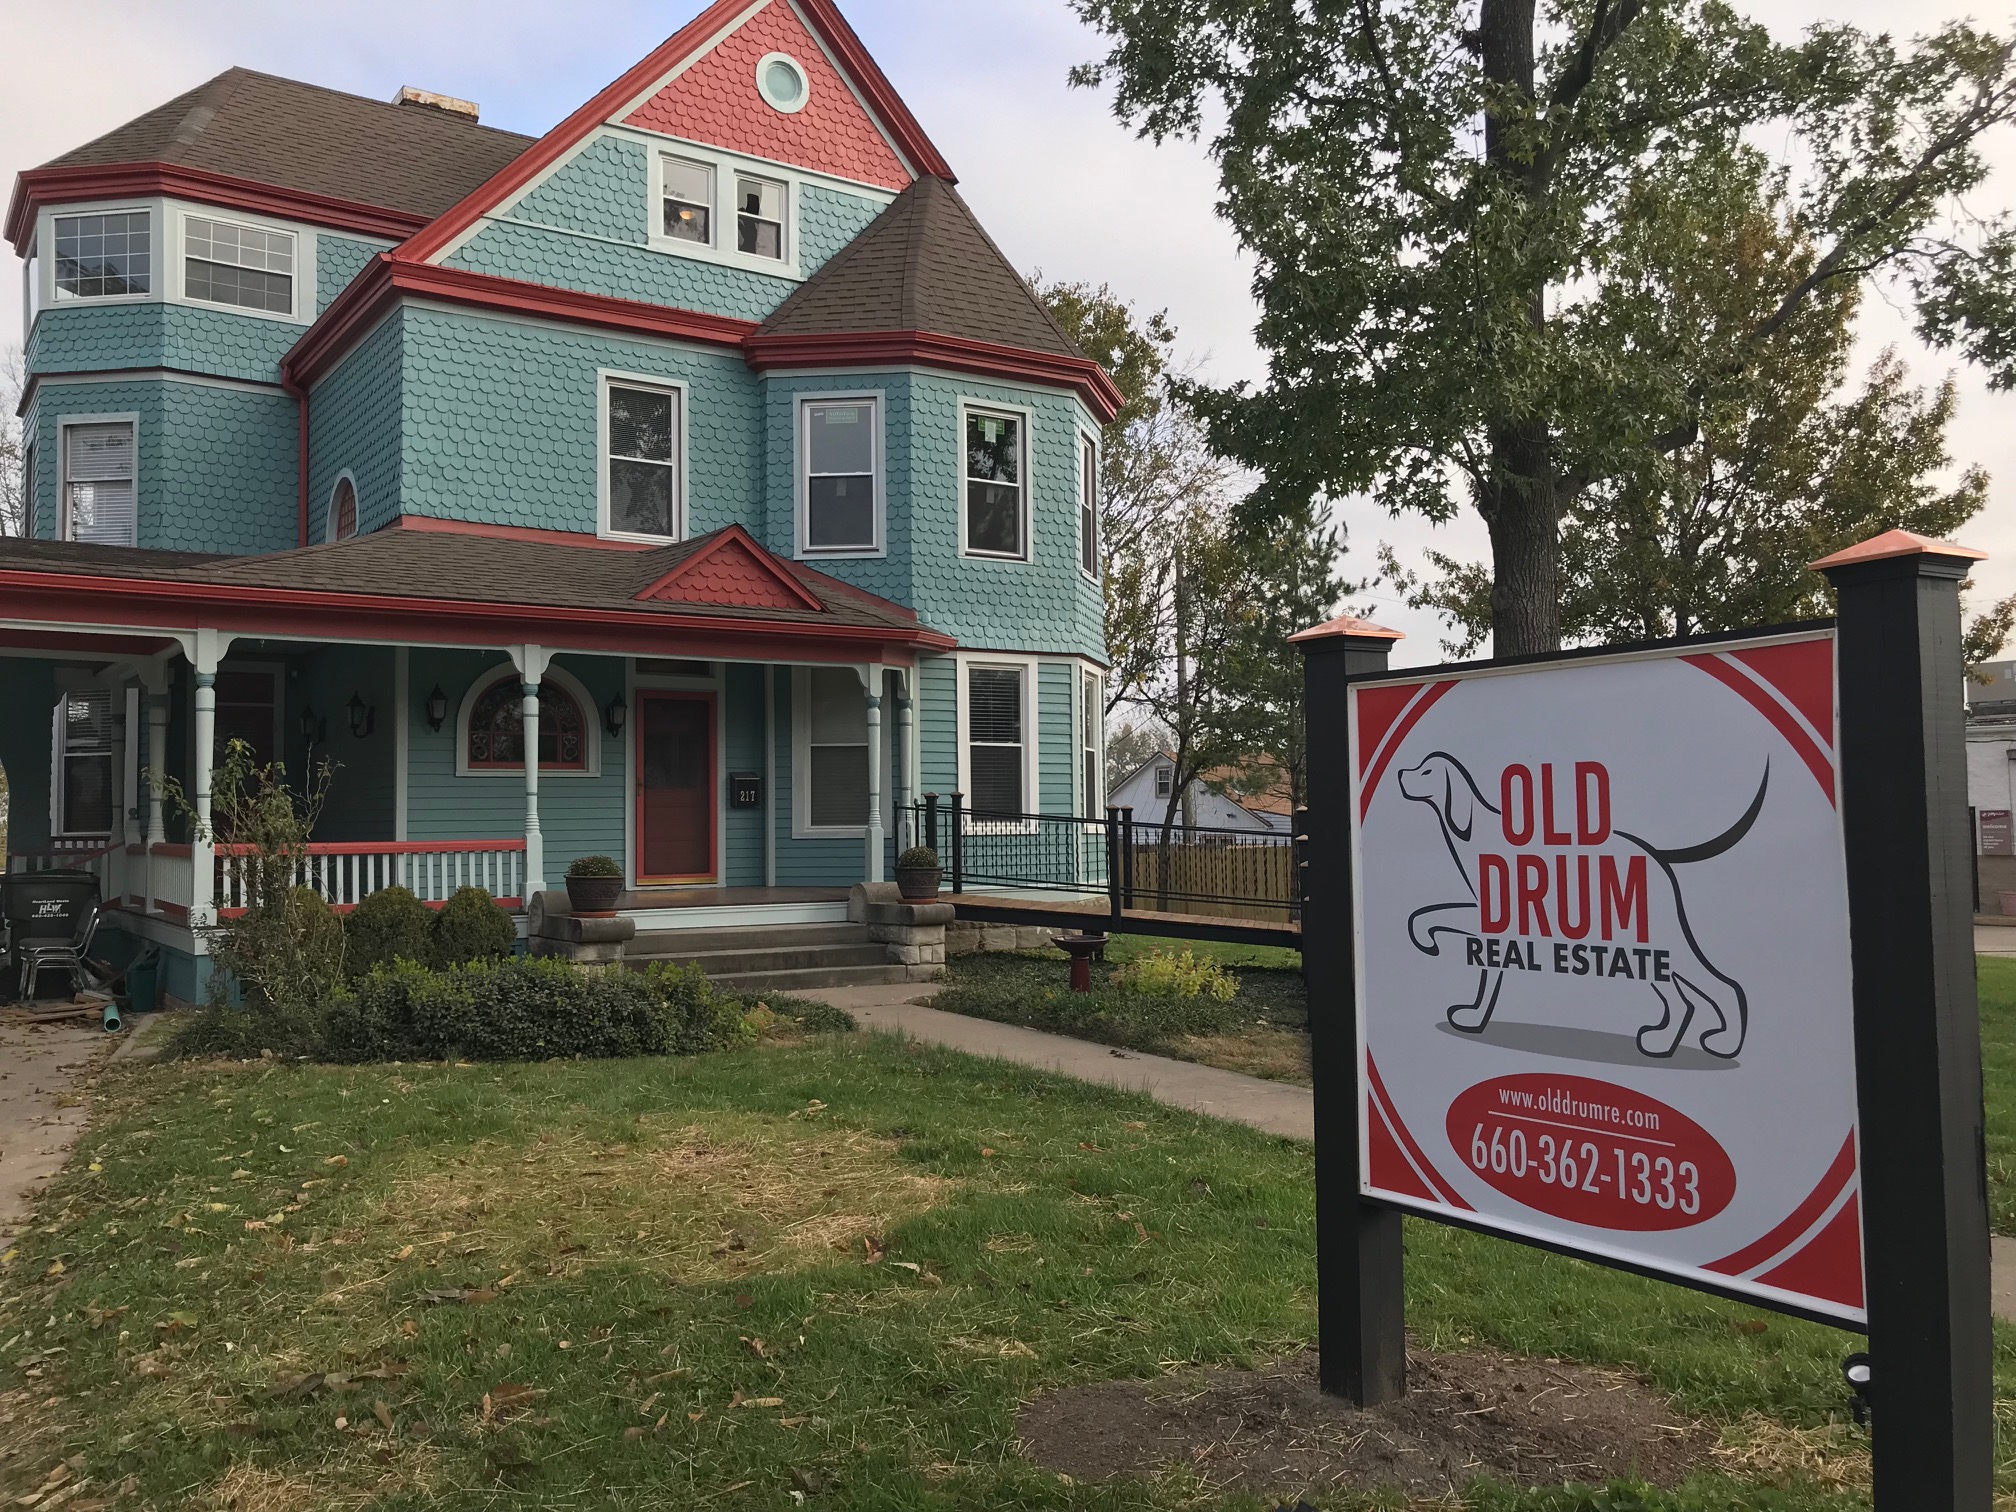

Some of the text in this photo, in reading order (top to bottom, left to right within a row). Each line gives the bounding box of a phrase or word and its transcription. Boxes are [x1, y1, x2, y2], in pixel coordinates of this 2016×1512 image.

[740, 790, 755, 801] 217
[1501, 761, 1611, 846] OLD
[39, 903, 62, 913] HLW
[1479, 854, 1649, 943] DRUM
[1466, 937, 1670, 982] REAL ESTATE
[1499, 1088, 1660, 1130] www.olddrumre.com
[1471, 1123, 1700, 1215] 660-362-1333
